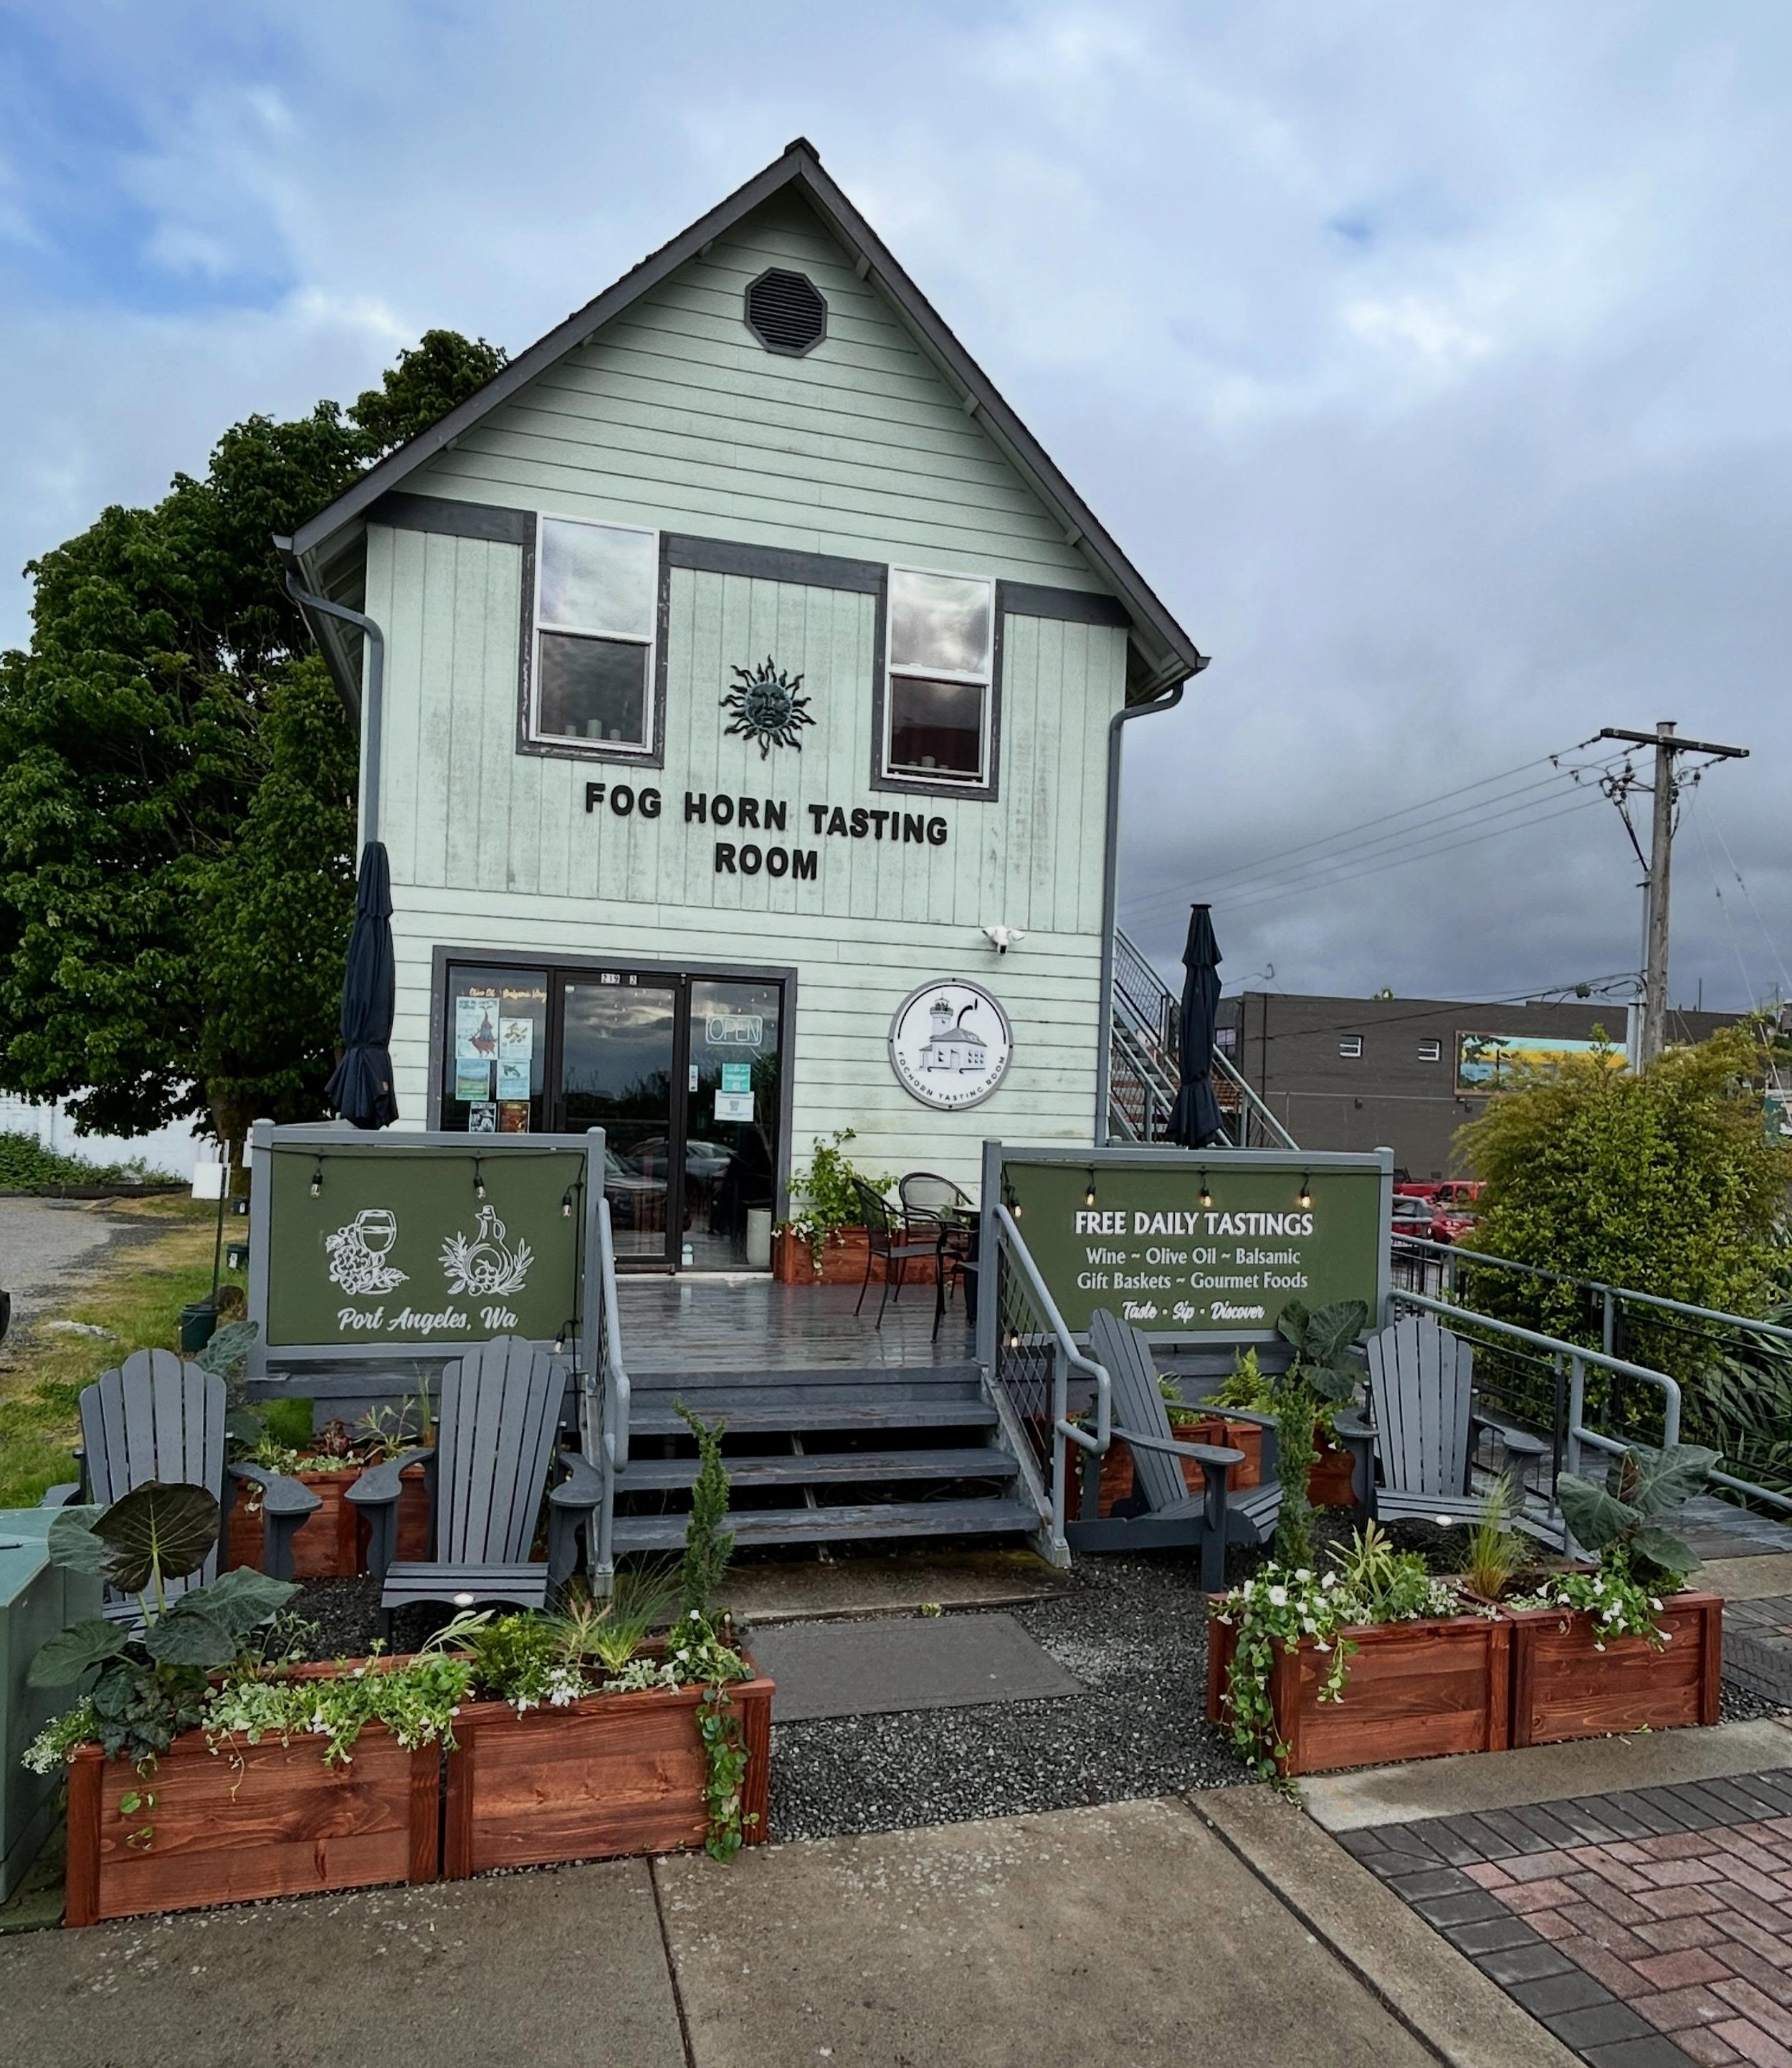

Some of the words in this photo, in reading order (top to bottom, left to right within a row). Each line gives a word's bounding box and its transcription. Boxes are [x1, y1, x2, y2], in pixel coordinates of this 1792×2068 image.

[586, 781, 662, 819] FOG
[685, 791, 787, 831] HORN
[808, 804, 948, 846] TASTING
[715, 842, 818, 881] ROOM
[603, 974, 619, 983] 219
[709, 1018, 759, 1042] OPEN
[986, 1056, 1005, 1085] ROOM
[1075, 1211, 1127, 1235] FREE
[1133, 1211, 1199, 1236] DAILY
[1204, 1212, 1314, 1236] TASTINGS
[1085, 1247, 1126, 1264] Wine
[1145, 1247, 1188, 1264] Olive
[1192, 1247, 1216, 1264] Oil
[1236, 1247, 1301, 1264] Balsamic
[1077, 1272, 1109, 1289] Gift
[1113, 1272, 1171, 1289] Baskets
[1190, 1272, 1259, 1289] Gourmet
[1264, 1272, 1308, 1288] Foods
[338, 1306, 385, 1330] Port
[386, 1305, 472, 1335] Angeles,
[480, 1306, 518, 1329] Wa
[1122, 1300, 1158, 1320] Taste
[1172, 1300, 1195, 1324] Sip
[1210, 1300, 1265, 1320] Discover
